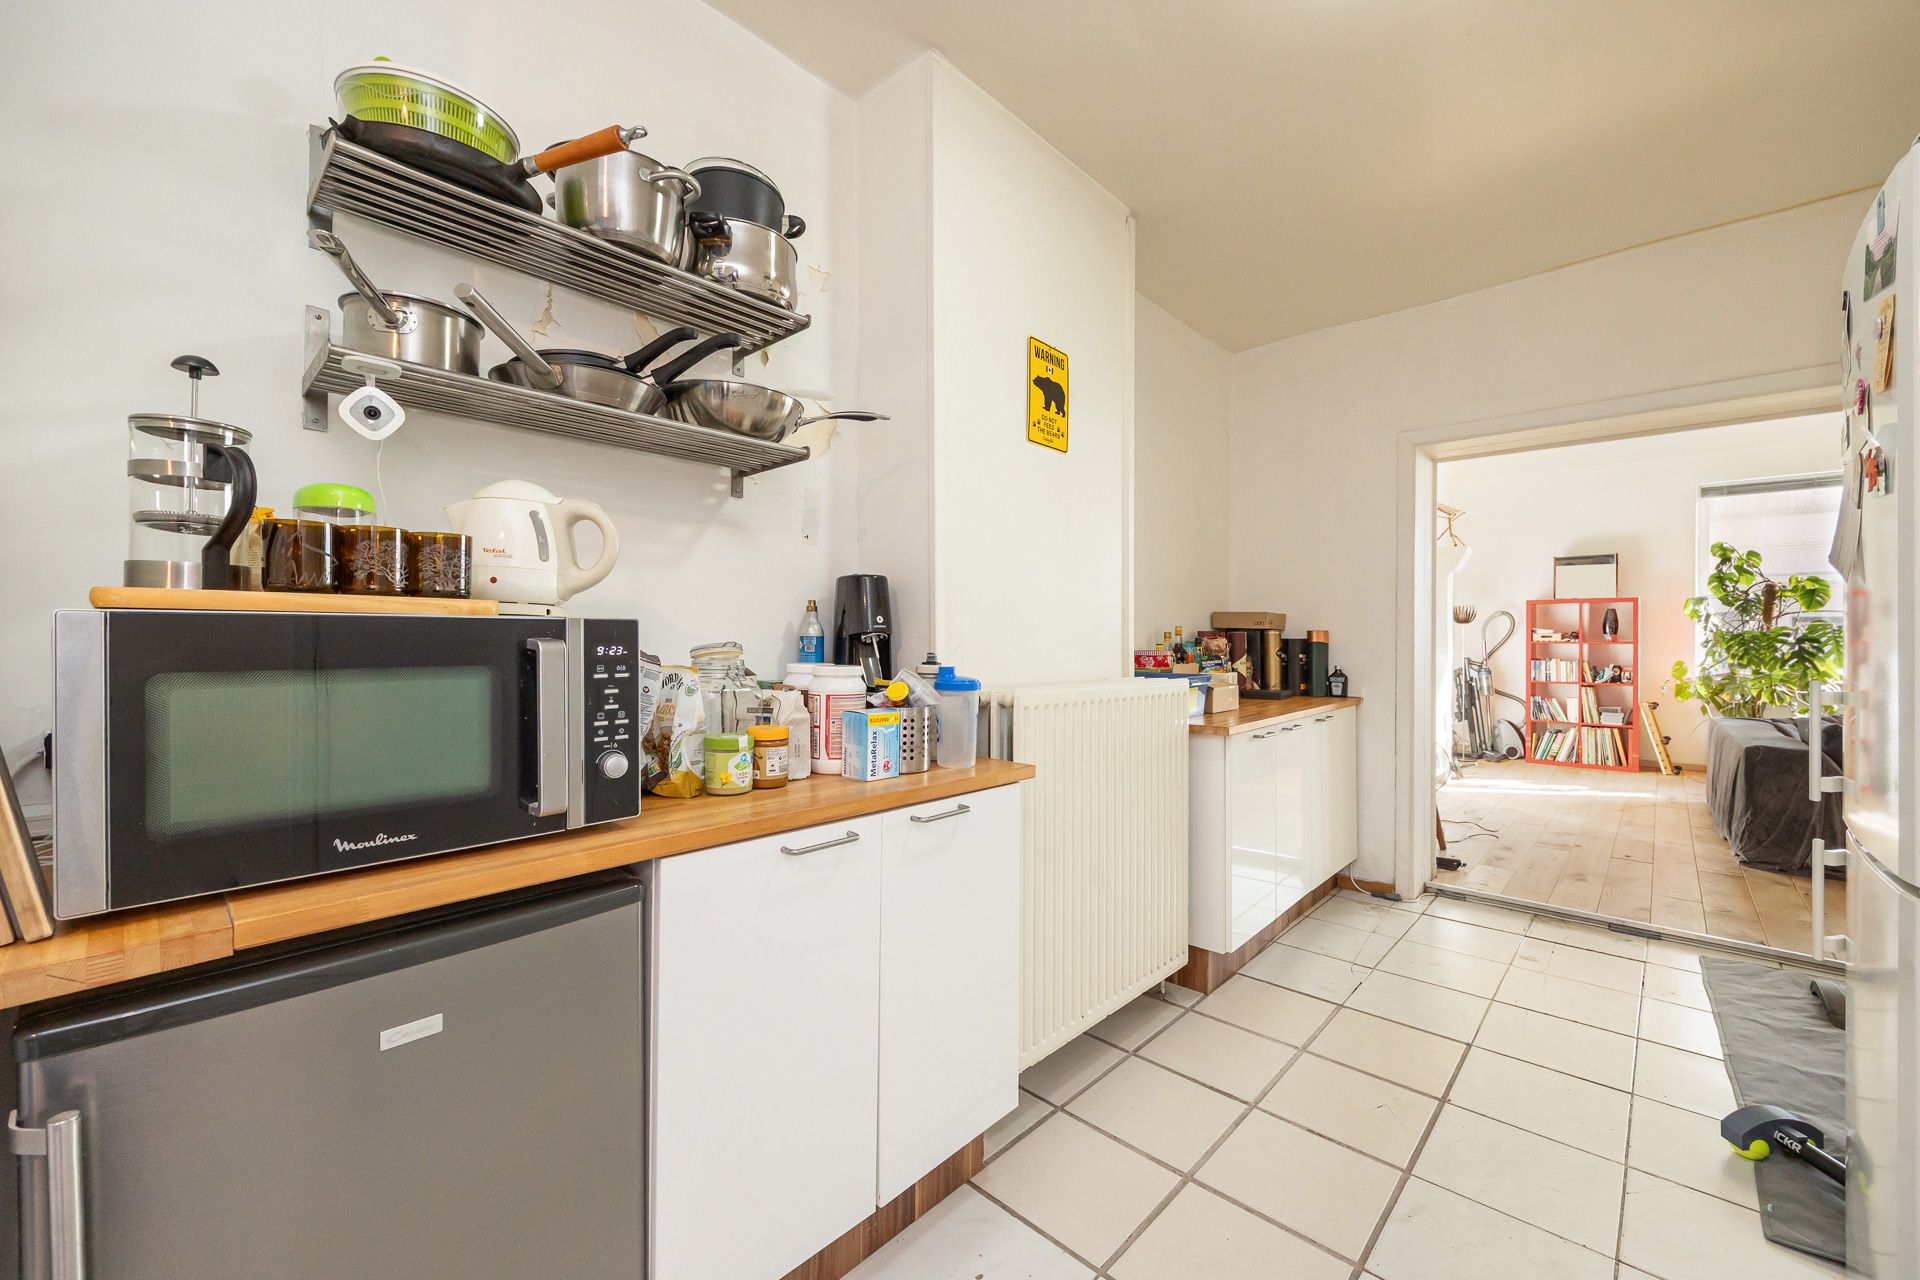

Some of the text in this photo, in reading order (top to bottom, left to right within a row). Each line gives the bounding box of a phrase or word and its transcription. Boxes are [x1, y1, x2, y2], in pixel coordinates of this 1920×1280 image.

[1034, 344, 1065, 371] WARNING
[1041, 413, 1058, 425] DO NOT
[1043, 421, 1055, 431] FEED
[1037, 425, 1061, 440] THE BEARS
[870, 730, 878, 777] MetaRelax
[333, 832, 418, 853] Moulinex
